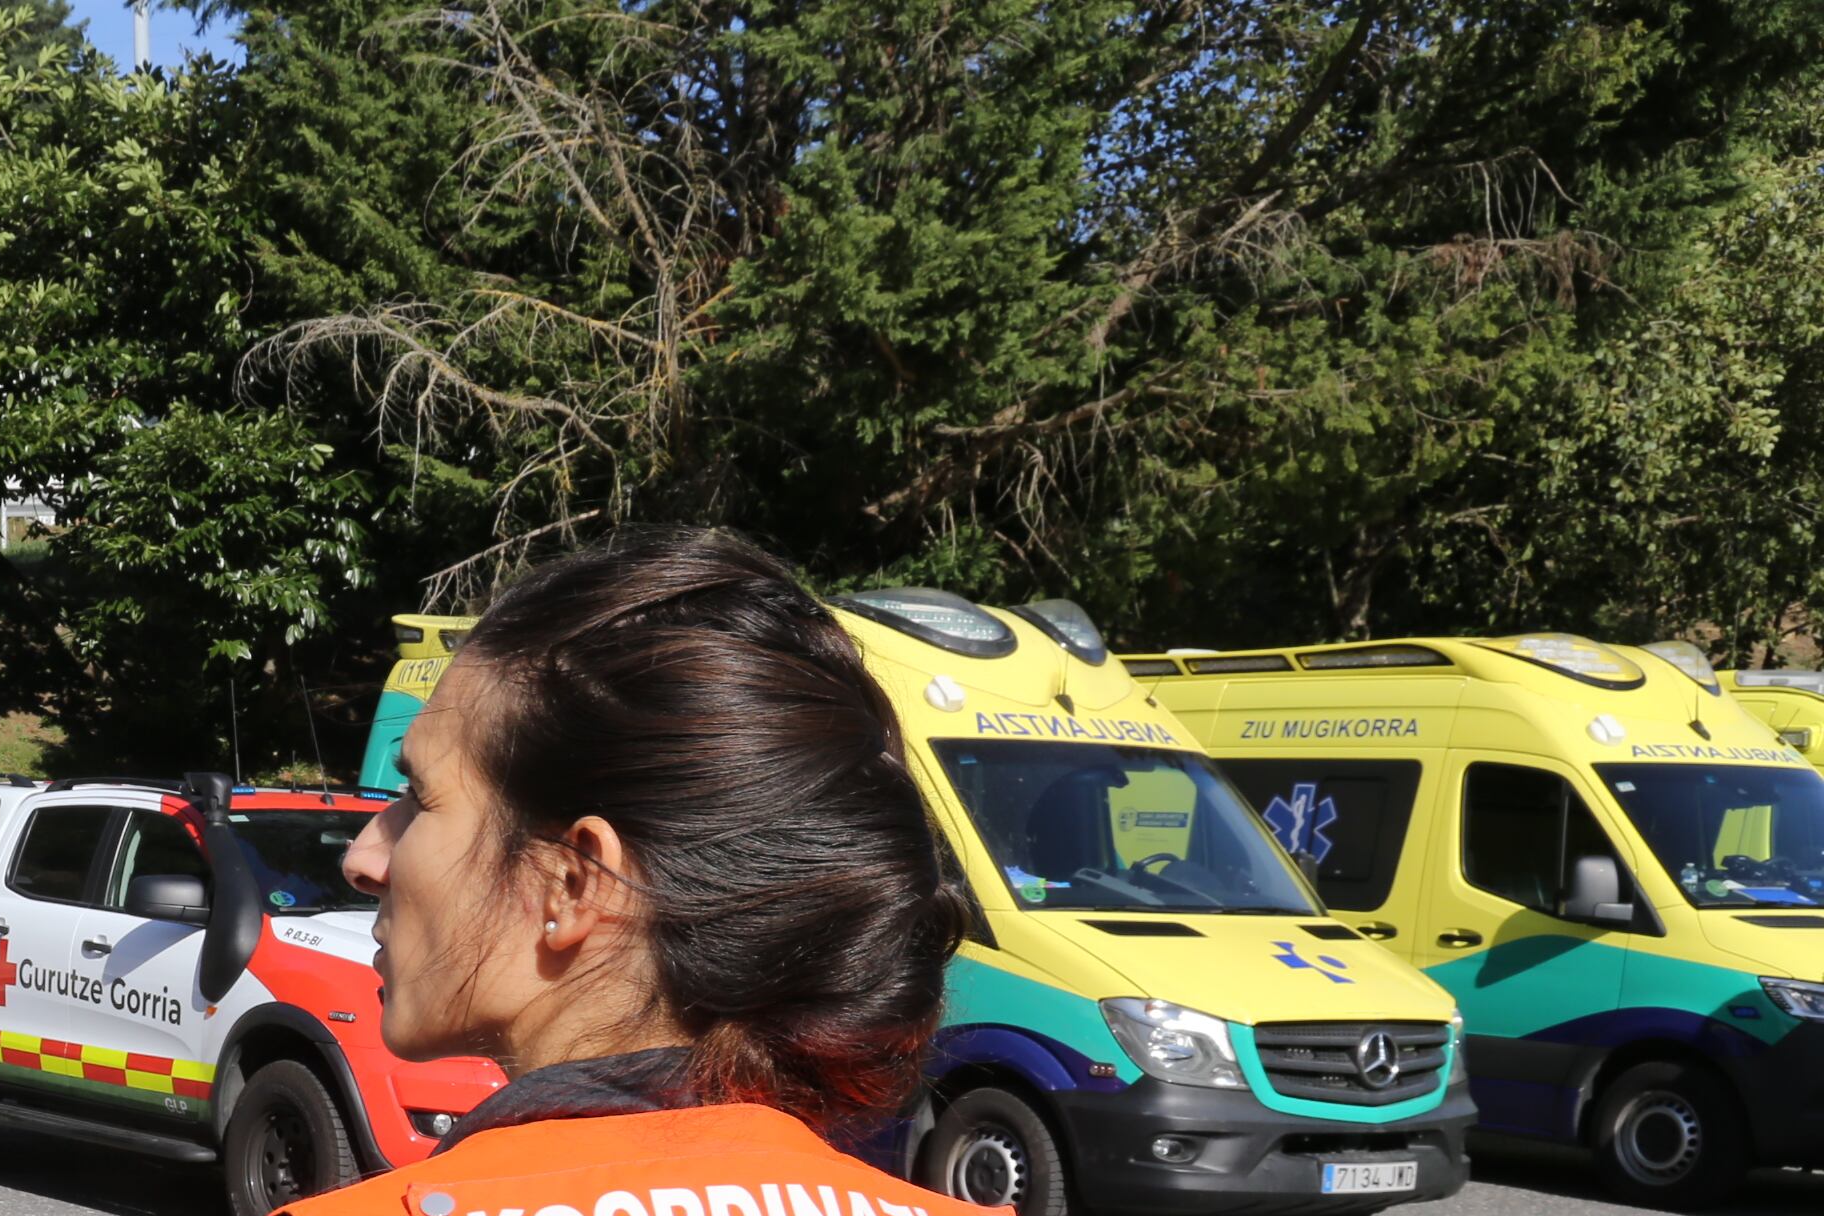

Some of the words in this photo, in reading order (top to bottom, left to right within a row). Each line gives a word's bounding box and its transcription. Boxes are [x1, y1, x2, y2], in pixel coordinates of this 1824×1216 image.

[1240, 720, 1276, 739] ZIU
[1280, 718, 1419, 739] MUGIKORRA
[19, 958, 103, 1005] Gurutze
[110, 977, 182, 1026] Gorria
[1336, 1167, 1381, 1190] 7134
